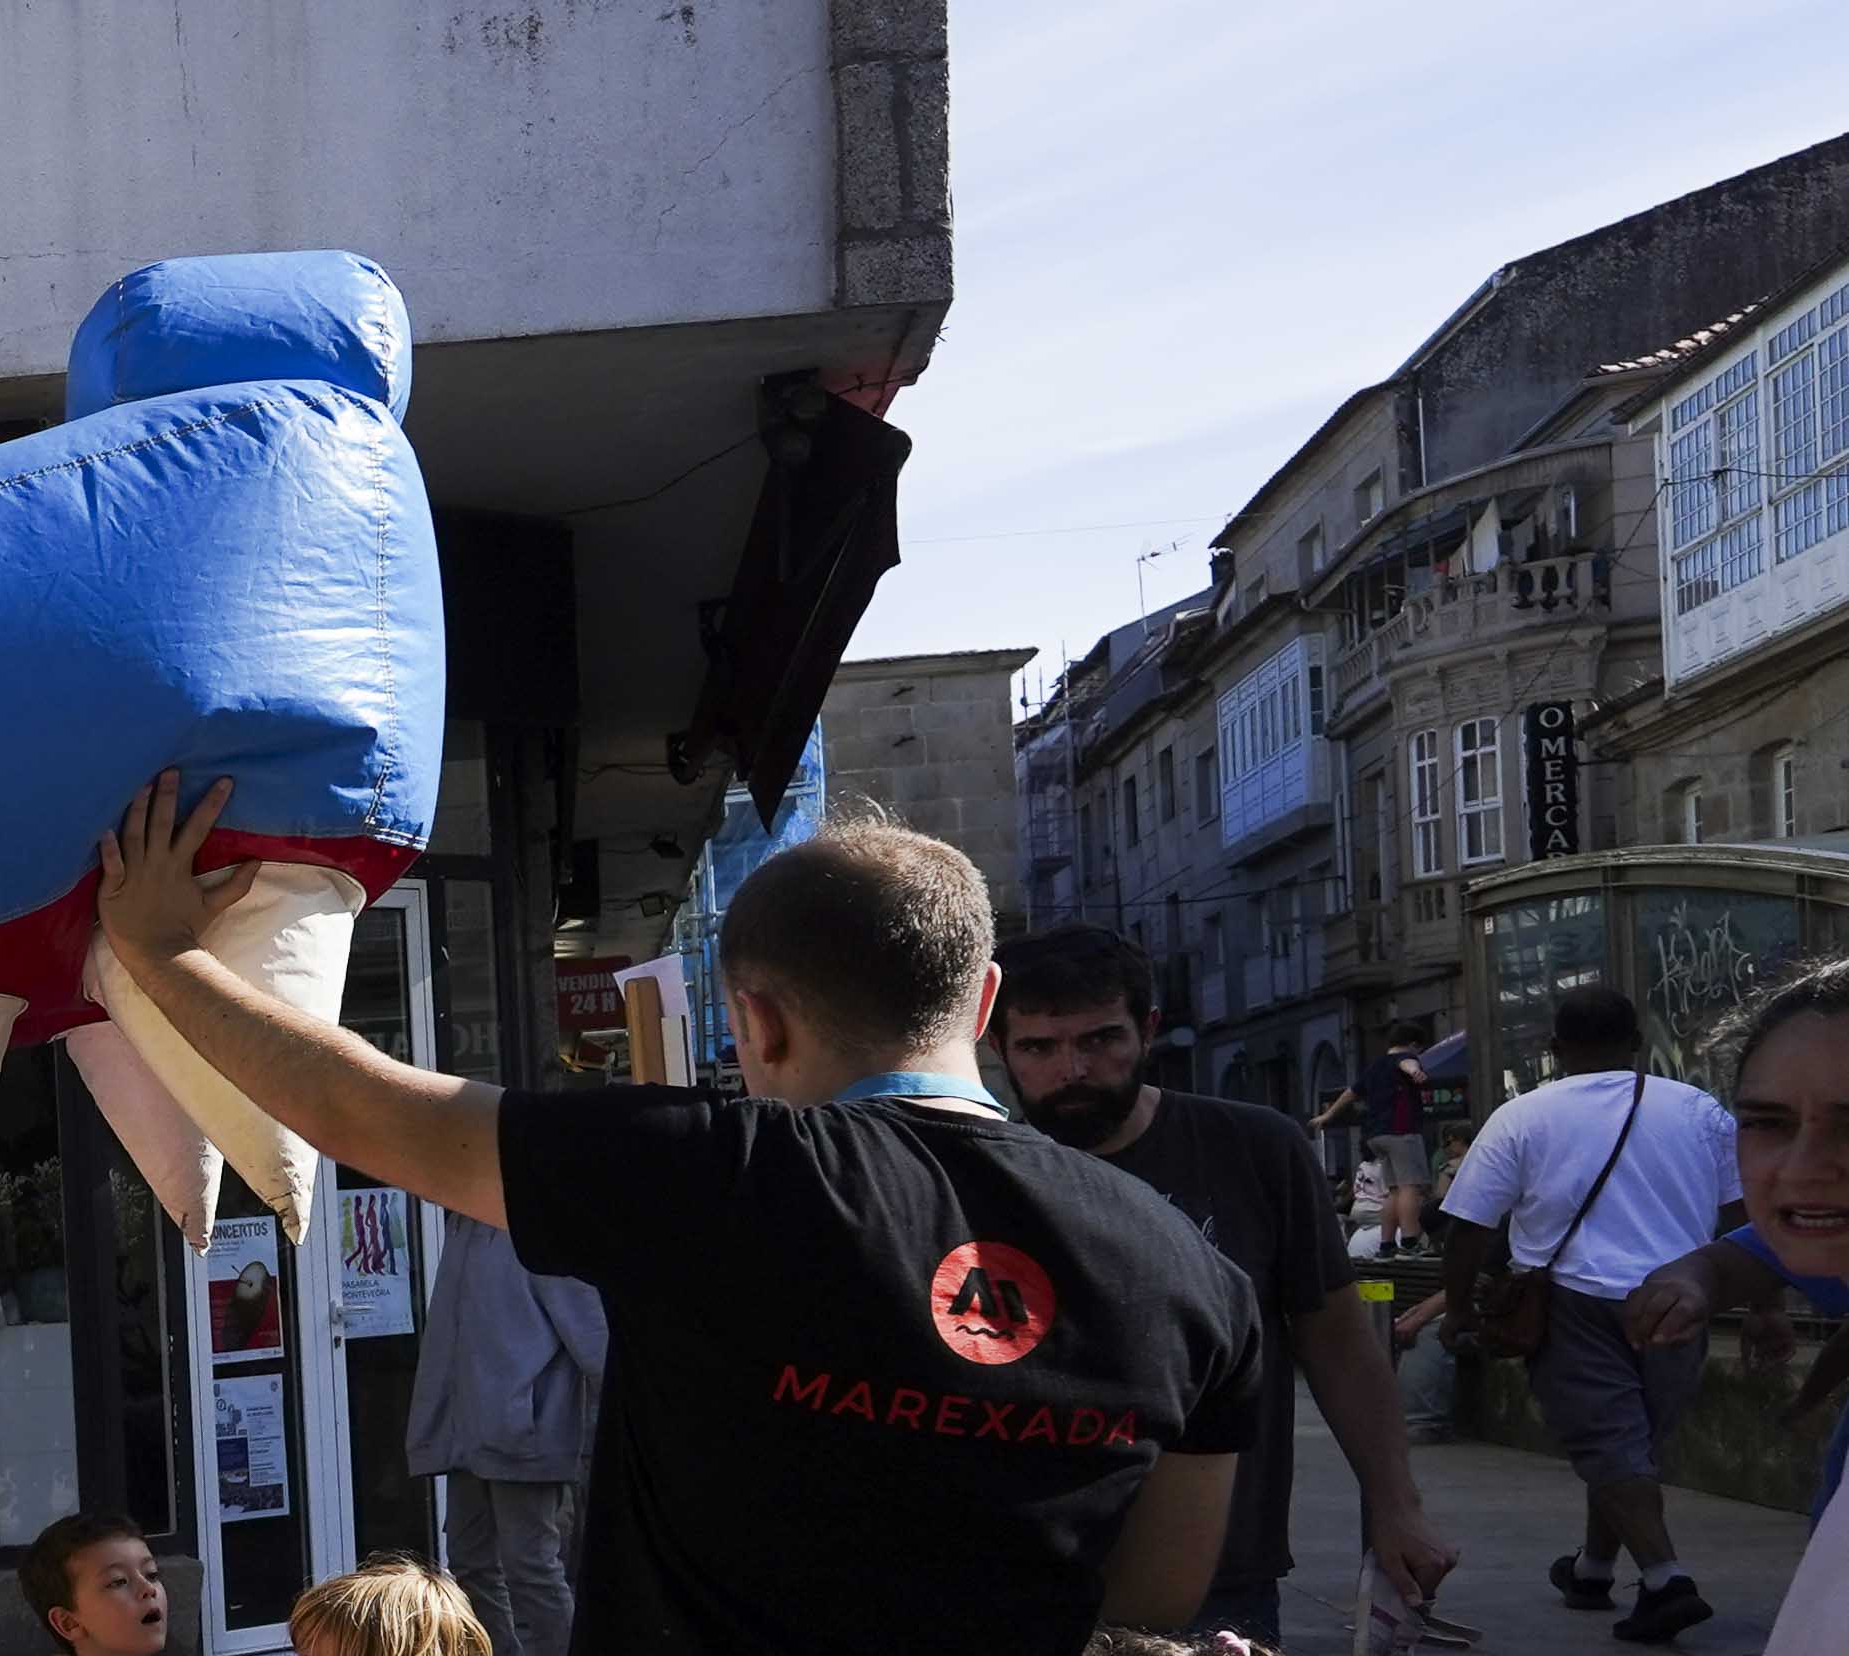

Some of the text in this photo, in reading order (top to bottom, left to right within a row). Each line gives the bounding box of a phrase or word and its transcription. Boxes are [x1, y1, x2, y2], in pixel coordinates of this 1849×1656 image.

[557, 972, 617, 992] VENDIN
[570, 991, 616, 1015] 24 H
[210, 1221, 269, 1241] ONCERTOS
[771, 1363, 1139, 1448] MAREXADA
